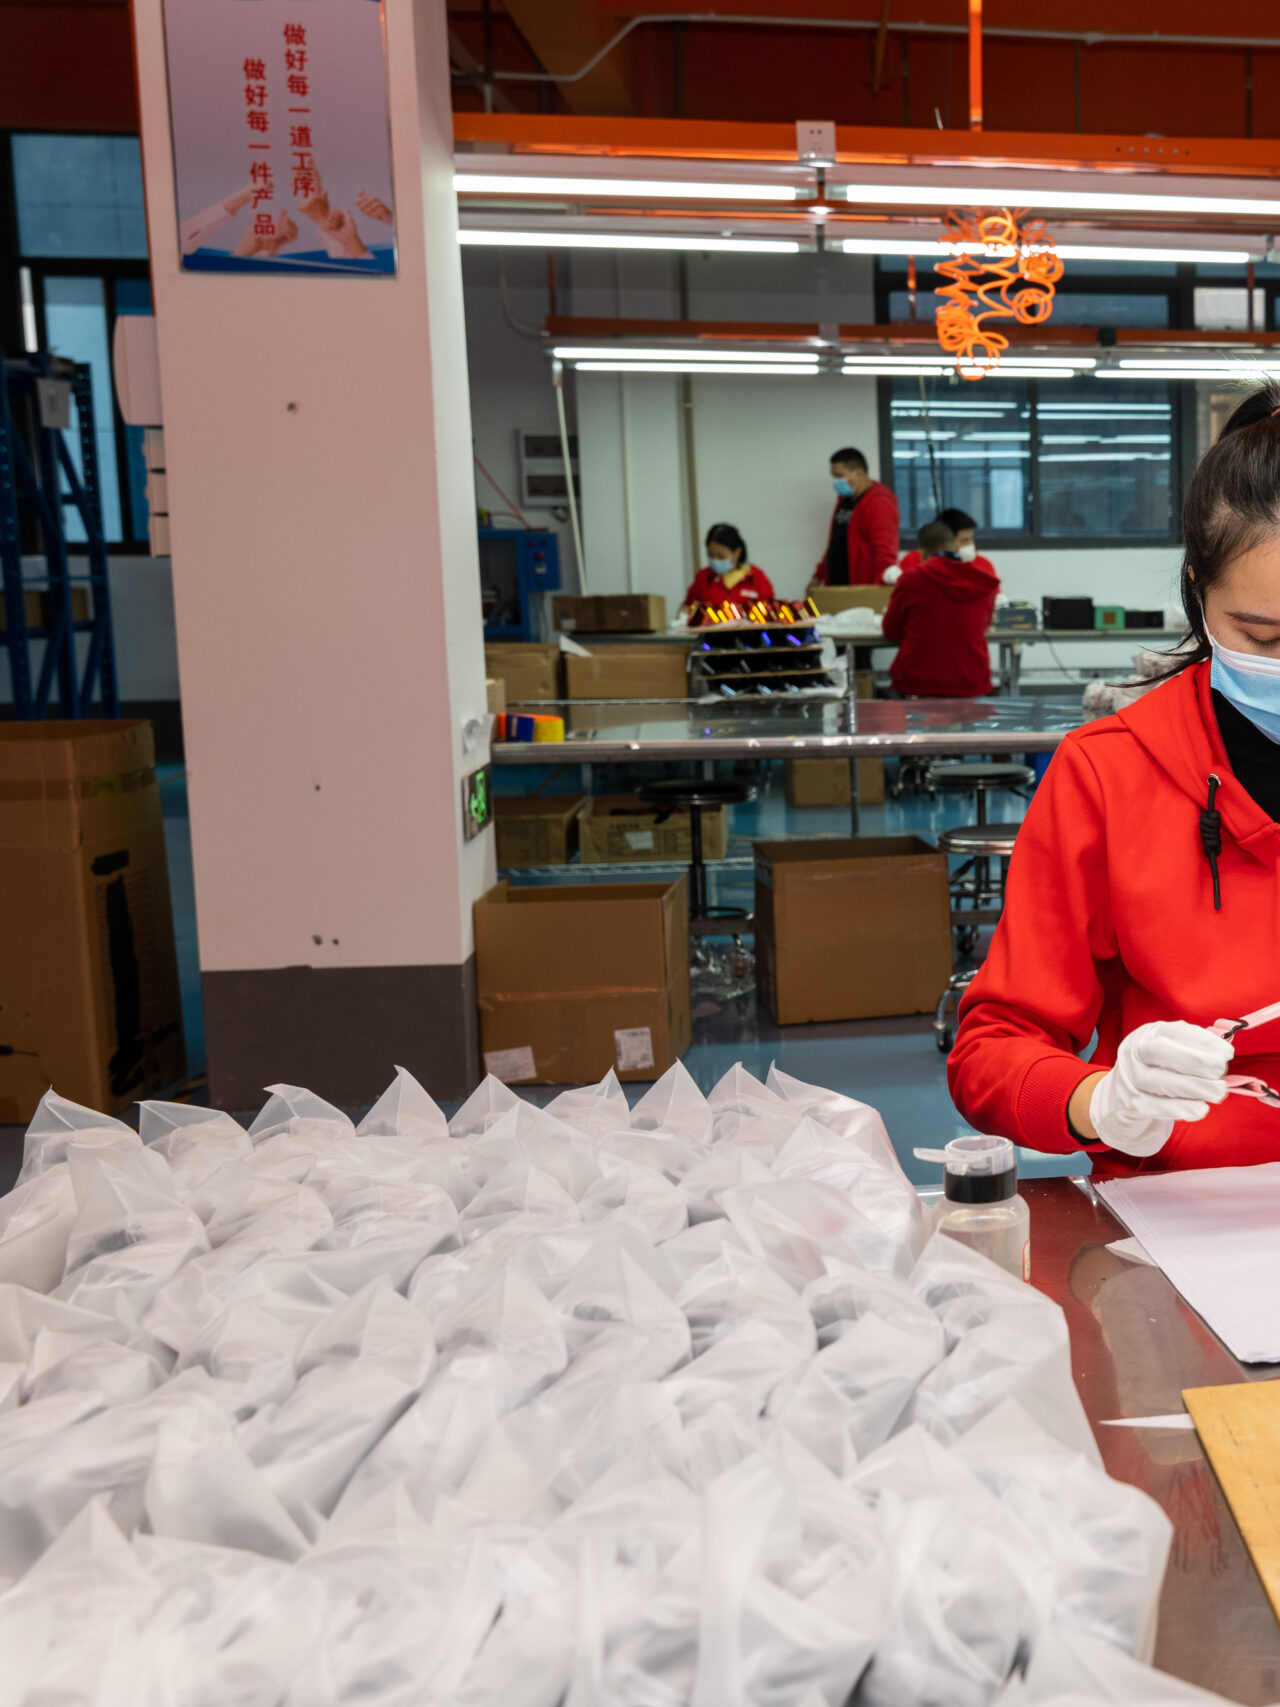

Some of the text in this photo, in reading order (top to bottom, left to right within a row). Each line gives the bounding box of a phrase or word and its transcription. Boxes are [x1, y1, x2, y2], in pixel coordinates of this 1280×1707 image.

[242, 58, 276, 236] 做好每一件产品
[283, 23, 315, 199] 做好每一道工序
